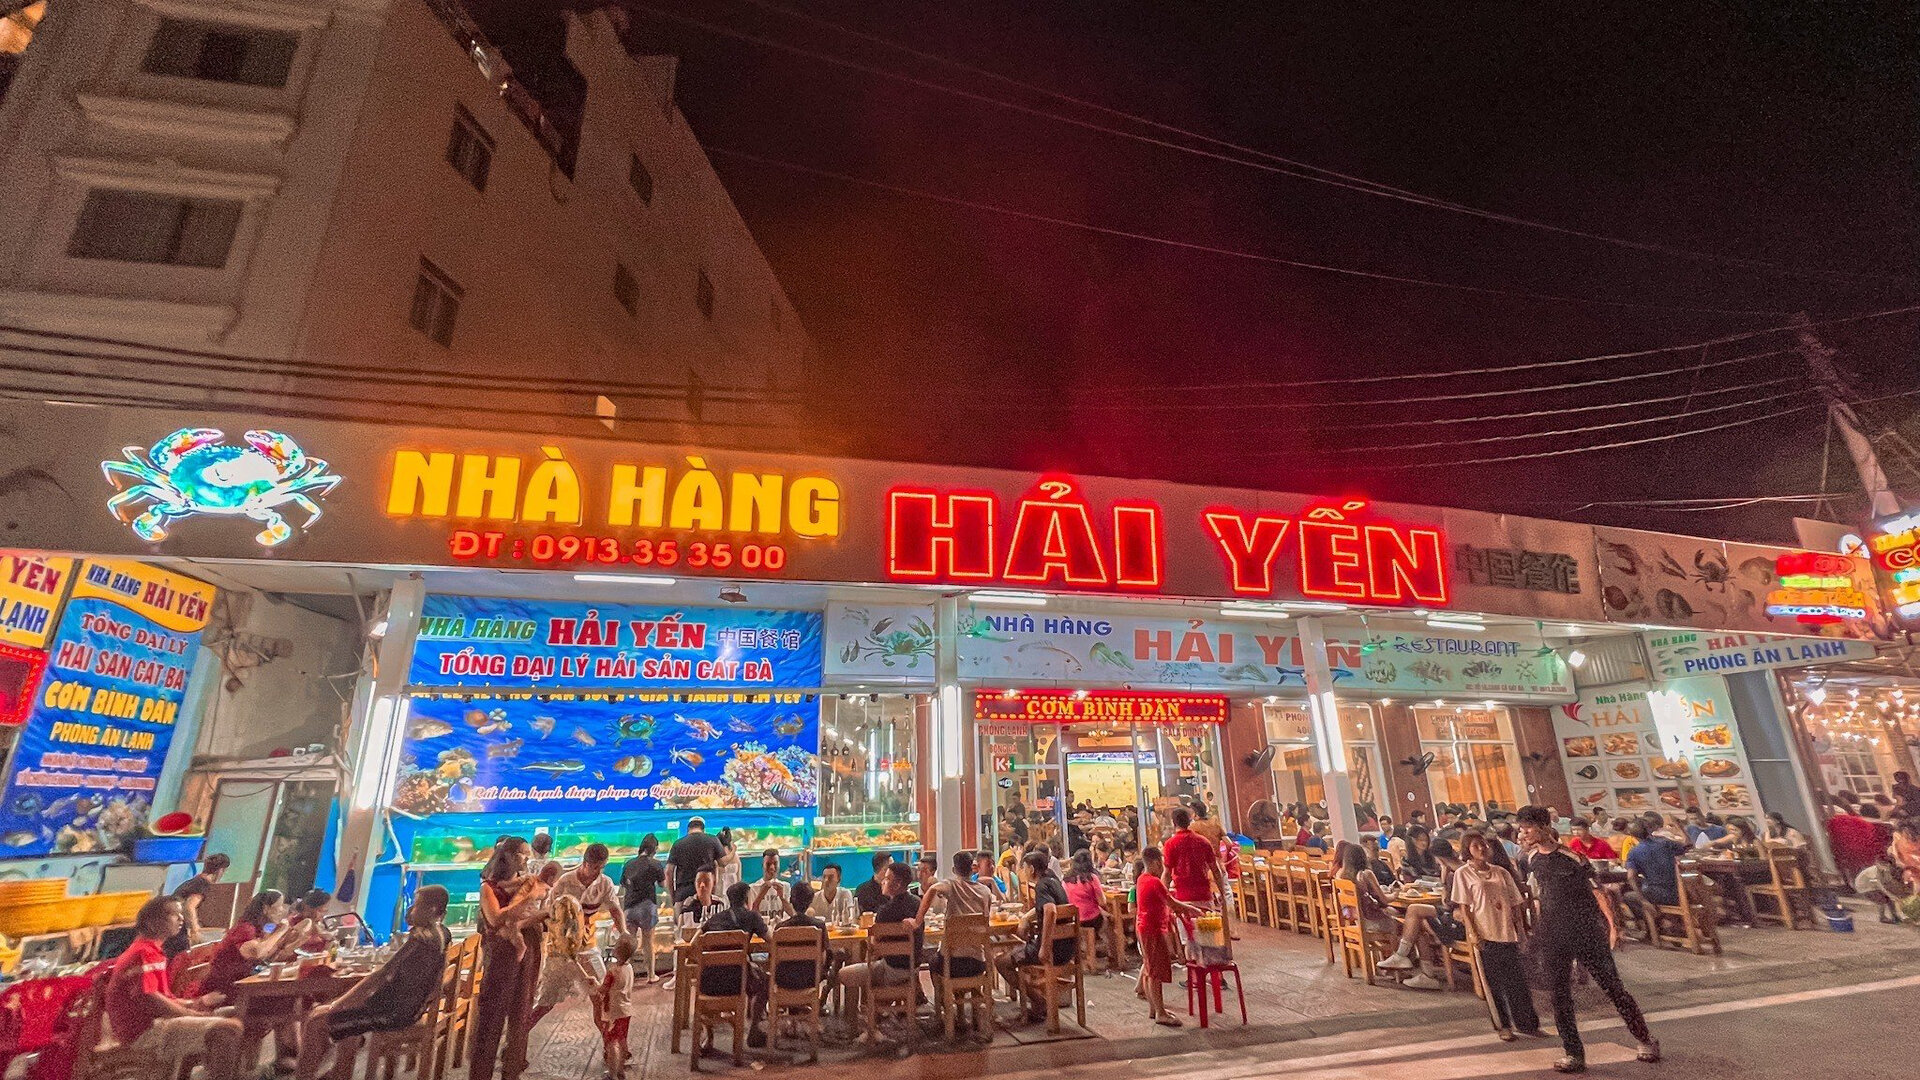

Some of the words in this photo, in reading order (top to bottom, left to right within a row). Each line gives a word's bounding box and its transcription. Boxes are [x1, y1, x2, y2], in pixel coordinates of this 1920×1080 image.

[386, 445, 582, 526] NHÀ
[607, 455, 840, 537] HÀNG
[450, 530, 505, 558] ĐT
[890, 480, 1158, 586] HẢI
[1206, 501, 1447, 602] YẾN
[111, 572, 142, 596] HÀNG
[142, 578, 176, 611] HẢI
[176, 591, 209, 622] YẾN
[81, 608, 131, 639] TỔNG
[135, 629, 167, 651] ĐẠI
[168, 638, 189, 655] LÝ
[418, 612, 466, 637] NHÀ
[471, 616, 536, 640] HÀNG
[546, 610, 620, 646] HẢI
[628, 613, 707, 649] YẾN
[716, 627, 802, 650] 中国餐馆
[985, 613, 1034, 633] NHÀ
[1044, 615, 1113, 637] HÀNG
[1134, 618, 1235, 663] HẢI
[57, 637, 94, 672] HẢI
[95, 645, 132, 679] SẢN
[134, 657, 164, 686] CÁT
[164, 665, 186, 690] BÀ
[439, 647, 505, 676] TỔNG
[513, 656, 554, 683] ĐẠI
[561, 652, 590, 678] LÝ
[597, 651, 636, 679] HẢI
[643, 653, 691, 680] SẢN
[696, 653, 738, 681] CÁT
[744, 657, 775, 682] BÀ
[1684, 652, 1748, 673] PHÒNG
[1753, 648, 1782, 664] ĂN
[1788, 641, 1847, 663] LẠNH
[44, 680, 92, 713] CƠM
[91, 684, 140, 719] BÌNH
[139, 693, 178, 725] DÂN
[1026, 700, 1075, 716] CƠM
[1083, 700, 1133, 717] BÌNH
[1139, 700, 1180, 717] DÂN
[50, 720, 100, 746] PHÒNG
[101, 724, 121, 746] ĂN
[122, 729, 155, 752] LẠNH
[473, 785, 499, 800] Rất
[499, 786, 527, 800] hân
[528, 786, 563, 801] hạnh
[564, 785, 597, 800] được
[596, 786, 631, 802] phục
[631, 788, 648, 800] vụ
[650, 784, 676, 799] Quý
